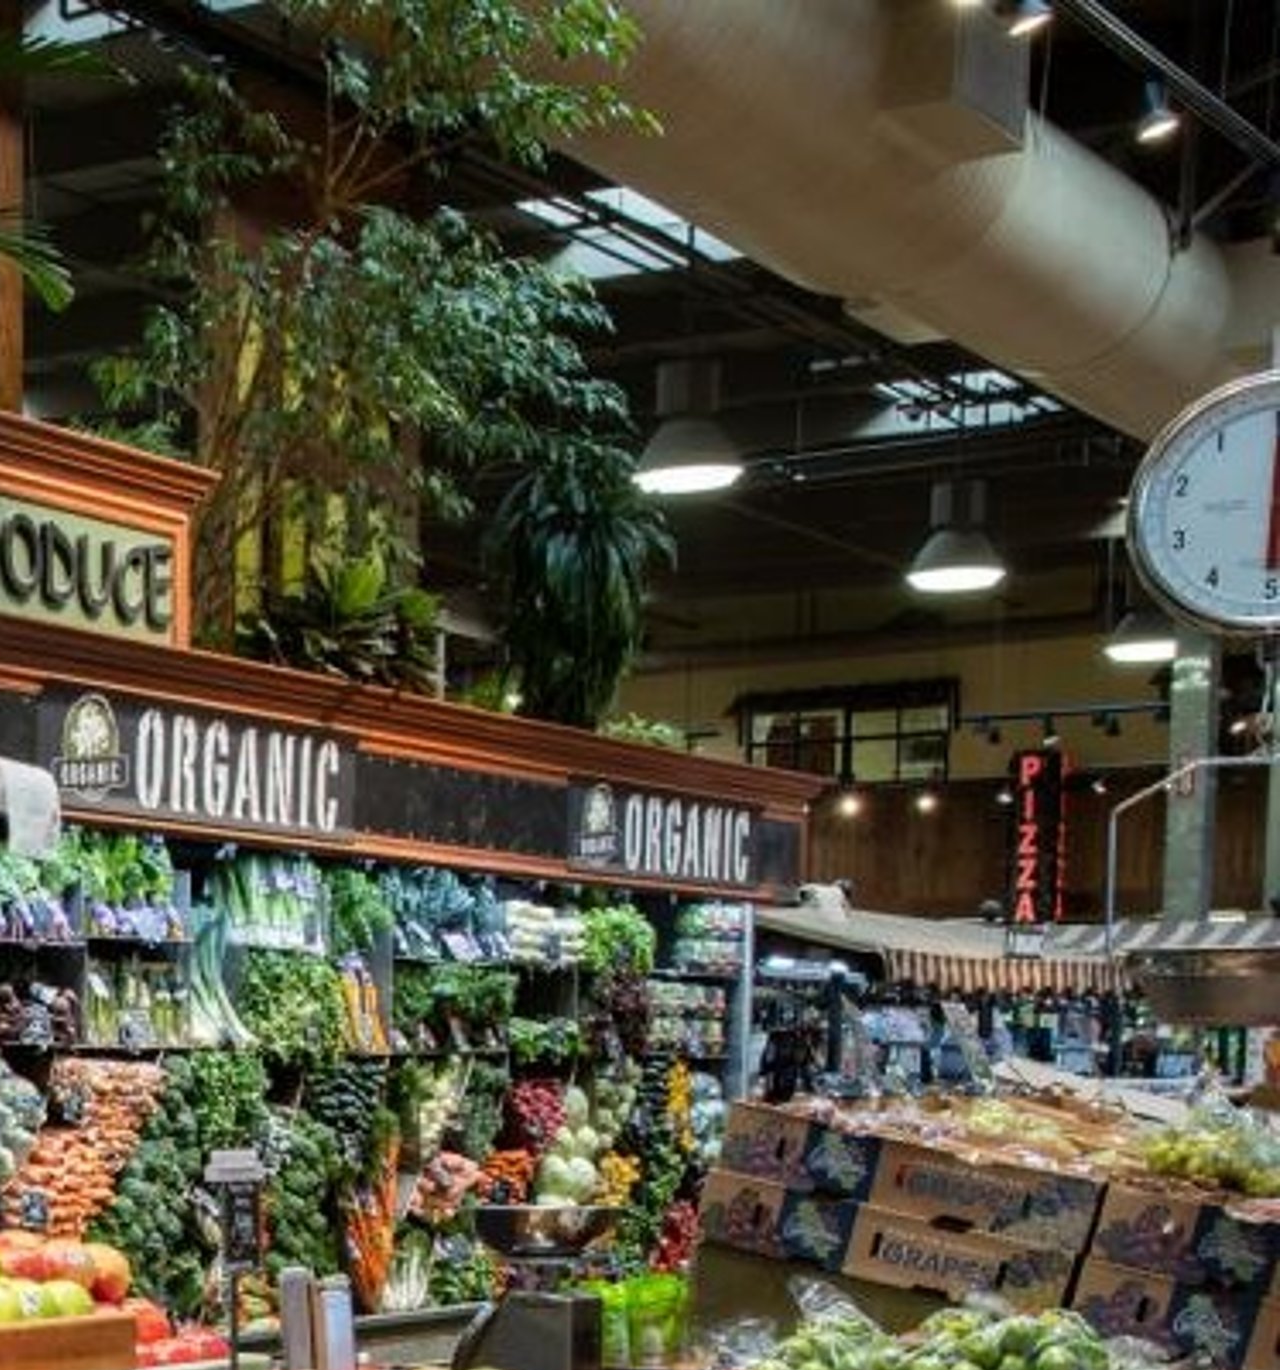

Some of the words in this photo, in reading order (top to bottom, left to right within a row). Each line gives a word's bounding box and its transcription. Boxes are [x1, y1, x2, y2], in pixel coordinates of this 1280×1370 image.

[1174, 475, 1189, 498] 2
[1173, 530, 1186, 551] 3
[1205, 566, 1219, 588] 4
[1265, 578, 1279, 601] 5
[136, 708, 340, 833] ORGANIC
[623, 793, 751, 883] ORGANIC
[1015, 755, 1042, 922] PIZZA
